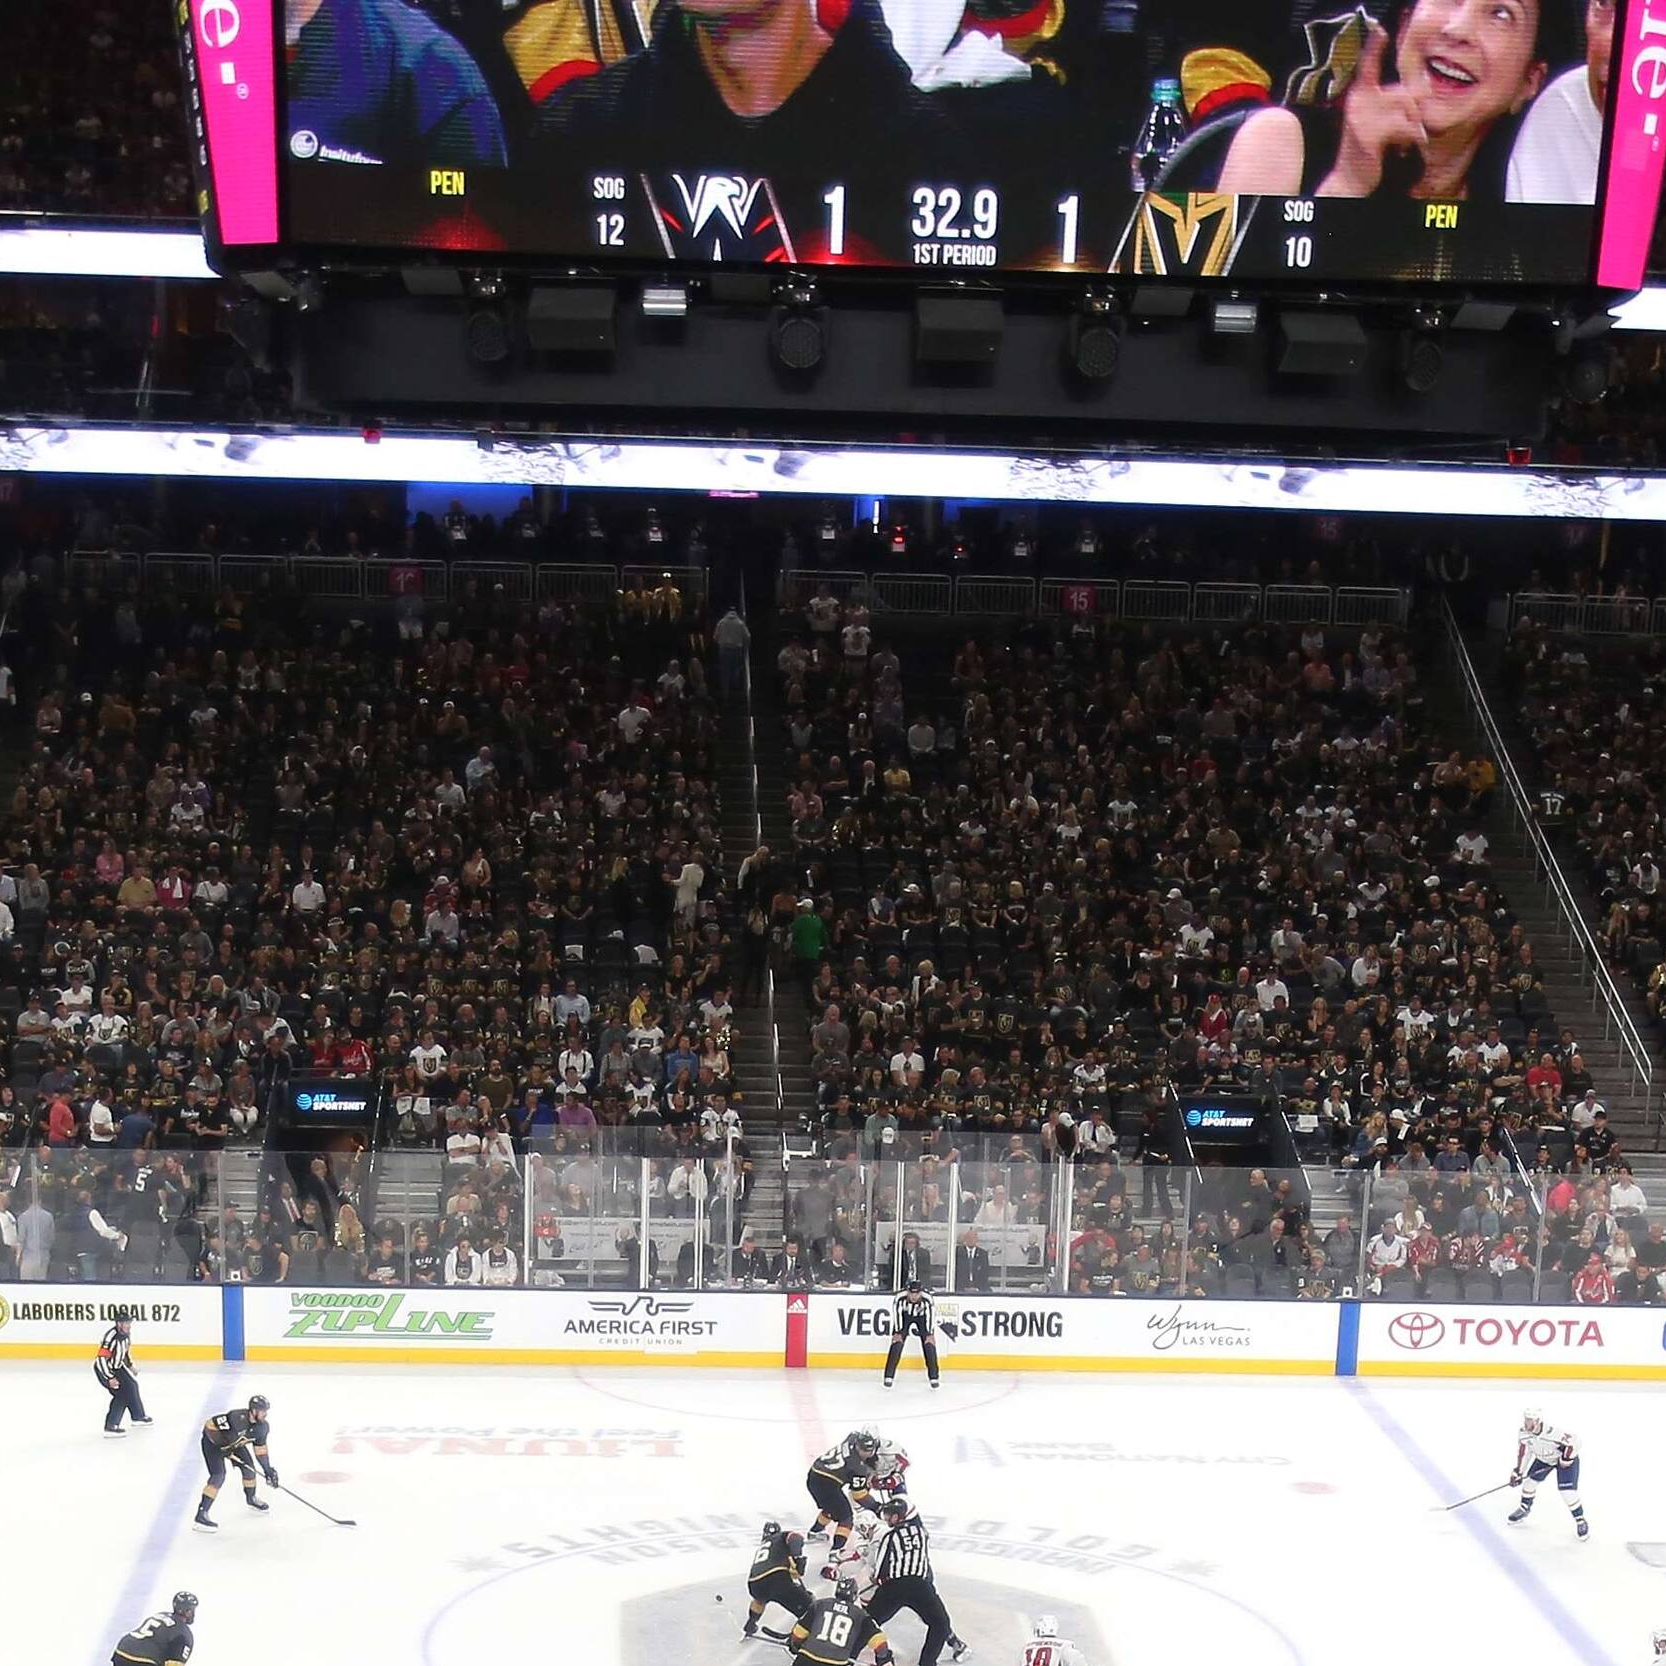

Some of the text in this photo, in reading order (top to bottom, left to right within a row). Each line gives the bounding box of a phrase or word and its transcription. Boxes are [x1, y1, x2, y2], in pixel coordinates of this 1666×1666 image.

[430, 170, 465, 196] PEN
[594, 177, 625, 199] SOG
[823, 185, 844, 255] 1
[912, 188, 997, 239] 32.9
[1284, 202, 1313, 222] SOG
[1425, 205, 1458, 229] PEN
[597, 215, 625, 246] 12
[1057, 195, 1079, 264] 1
[914, 244, 996, 266] 1ST PERIOD
[1285, 238, 1311, 268] 10
[1070, 590, 1089, 611] 15
[13, 1302, 95, 1321] LABORERS
[151, 1304, 181, 1322] 872
[290, 1293, 384, 1308] VOODOO
[563, 1319, 718, 1336] AMERICA FIRST
[960, 1310, 1063, 1338] STRONG
[1147, 1304, 1245, 1350] Wynn
[1453, 1318, 1605, 1347] TOYOTA
[647, 1338, 683, 1346] UNION
[1183, 1336, 1250, 1346] LAS VEGAS
[853, 1477, 866, 1488] 57
[817, 1609, 853, 1647] 18
